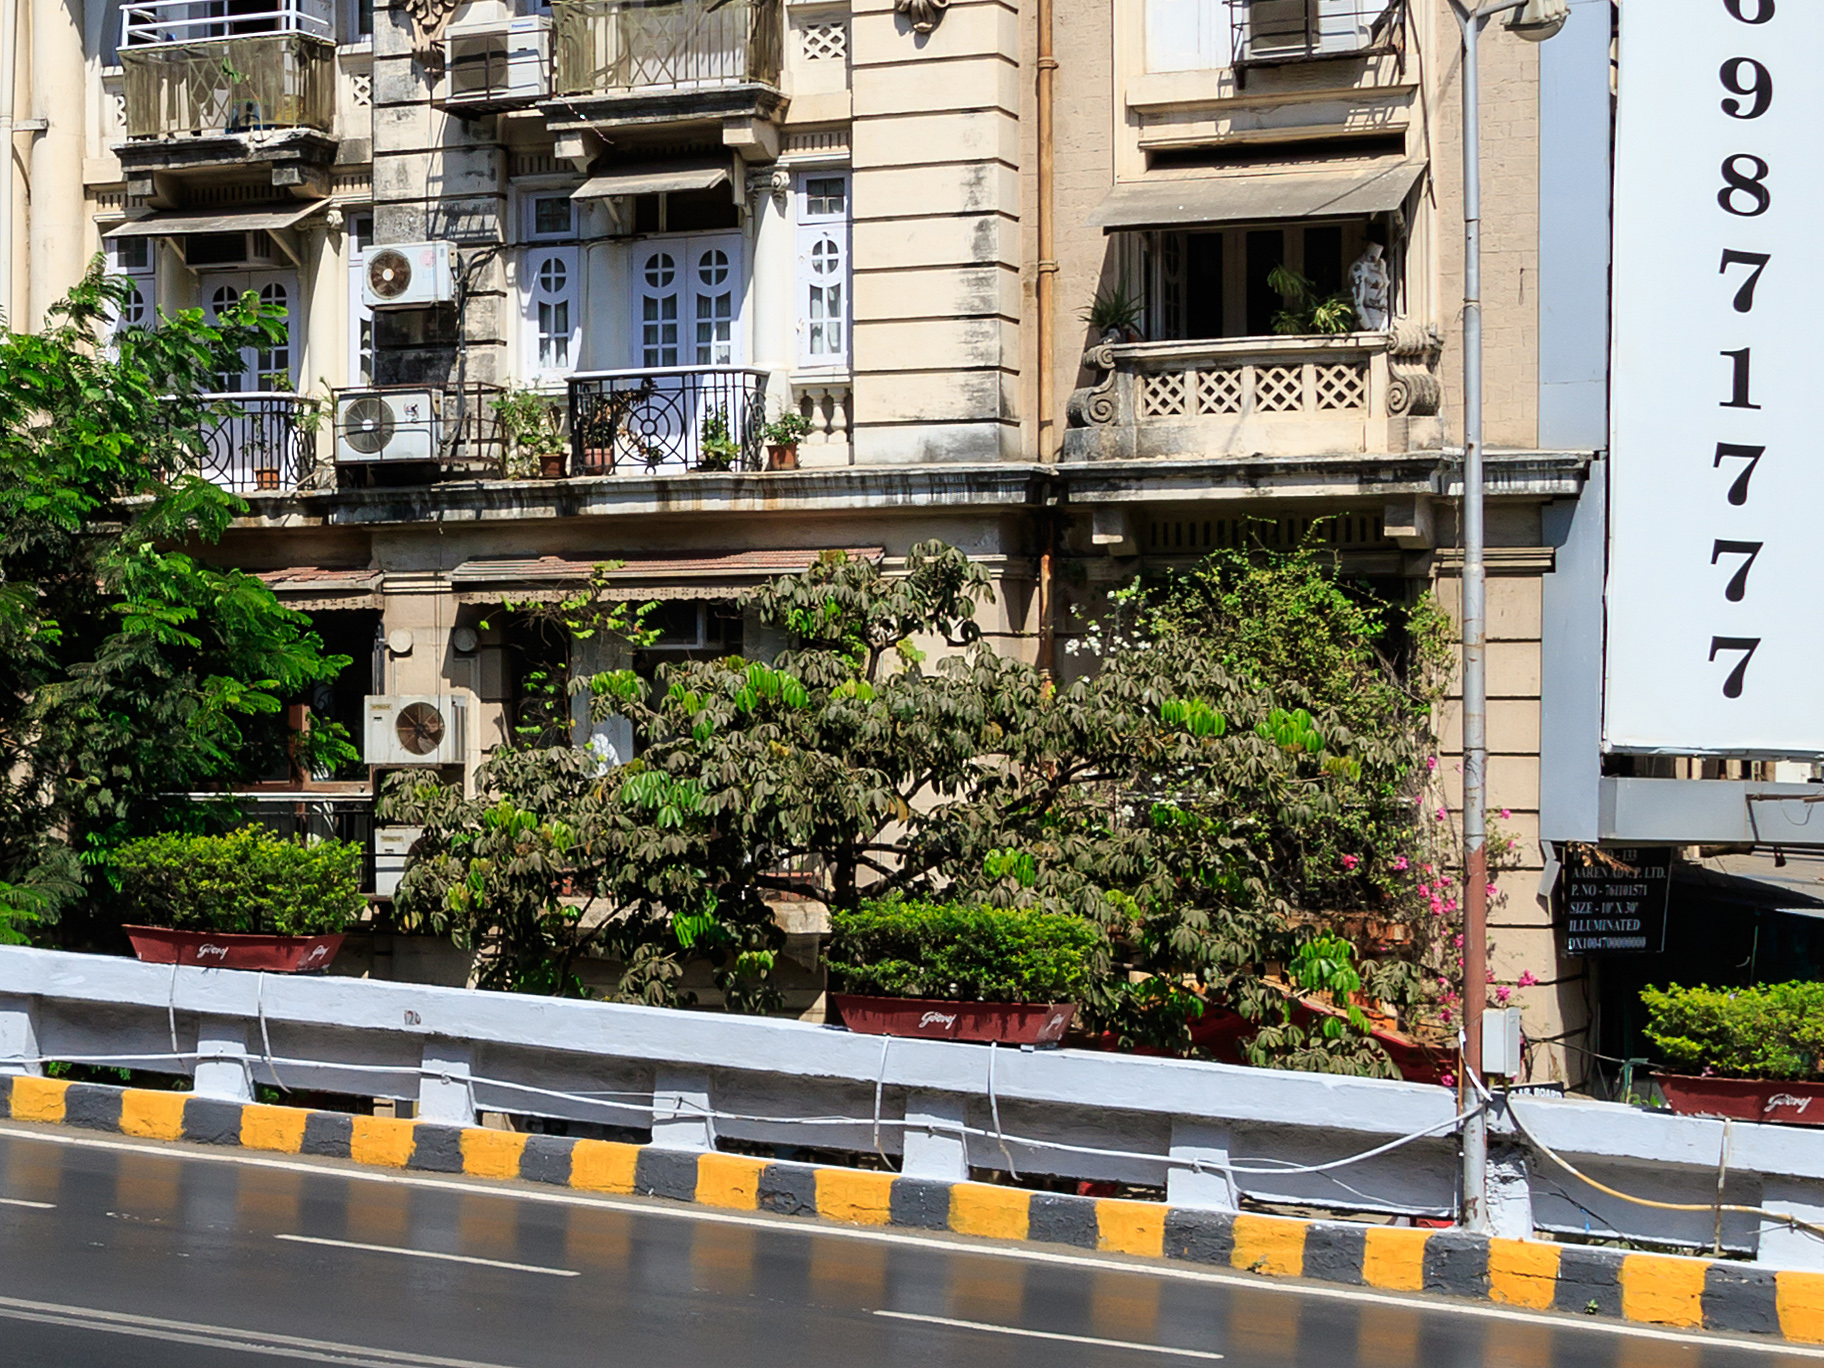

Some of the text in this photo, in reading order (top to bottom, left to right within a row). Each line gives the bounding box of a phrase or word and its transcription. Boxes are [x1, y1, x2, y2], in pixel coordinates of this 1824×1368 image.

[1645, 867, 1666, 879] LTD.
[1569, 902, 1593, 913] SIZE
[1569, 919, 1641, 931] ILLUMINATED
